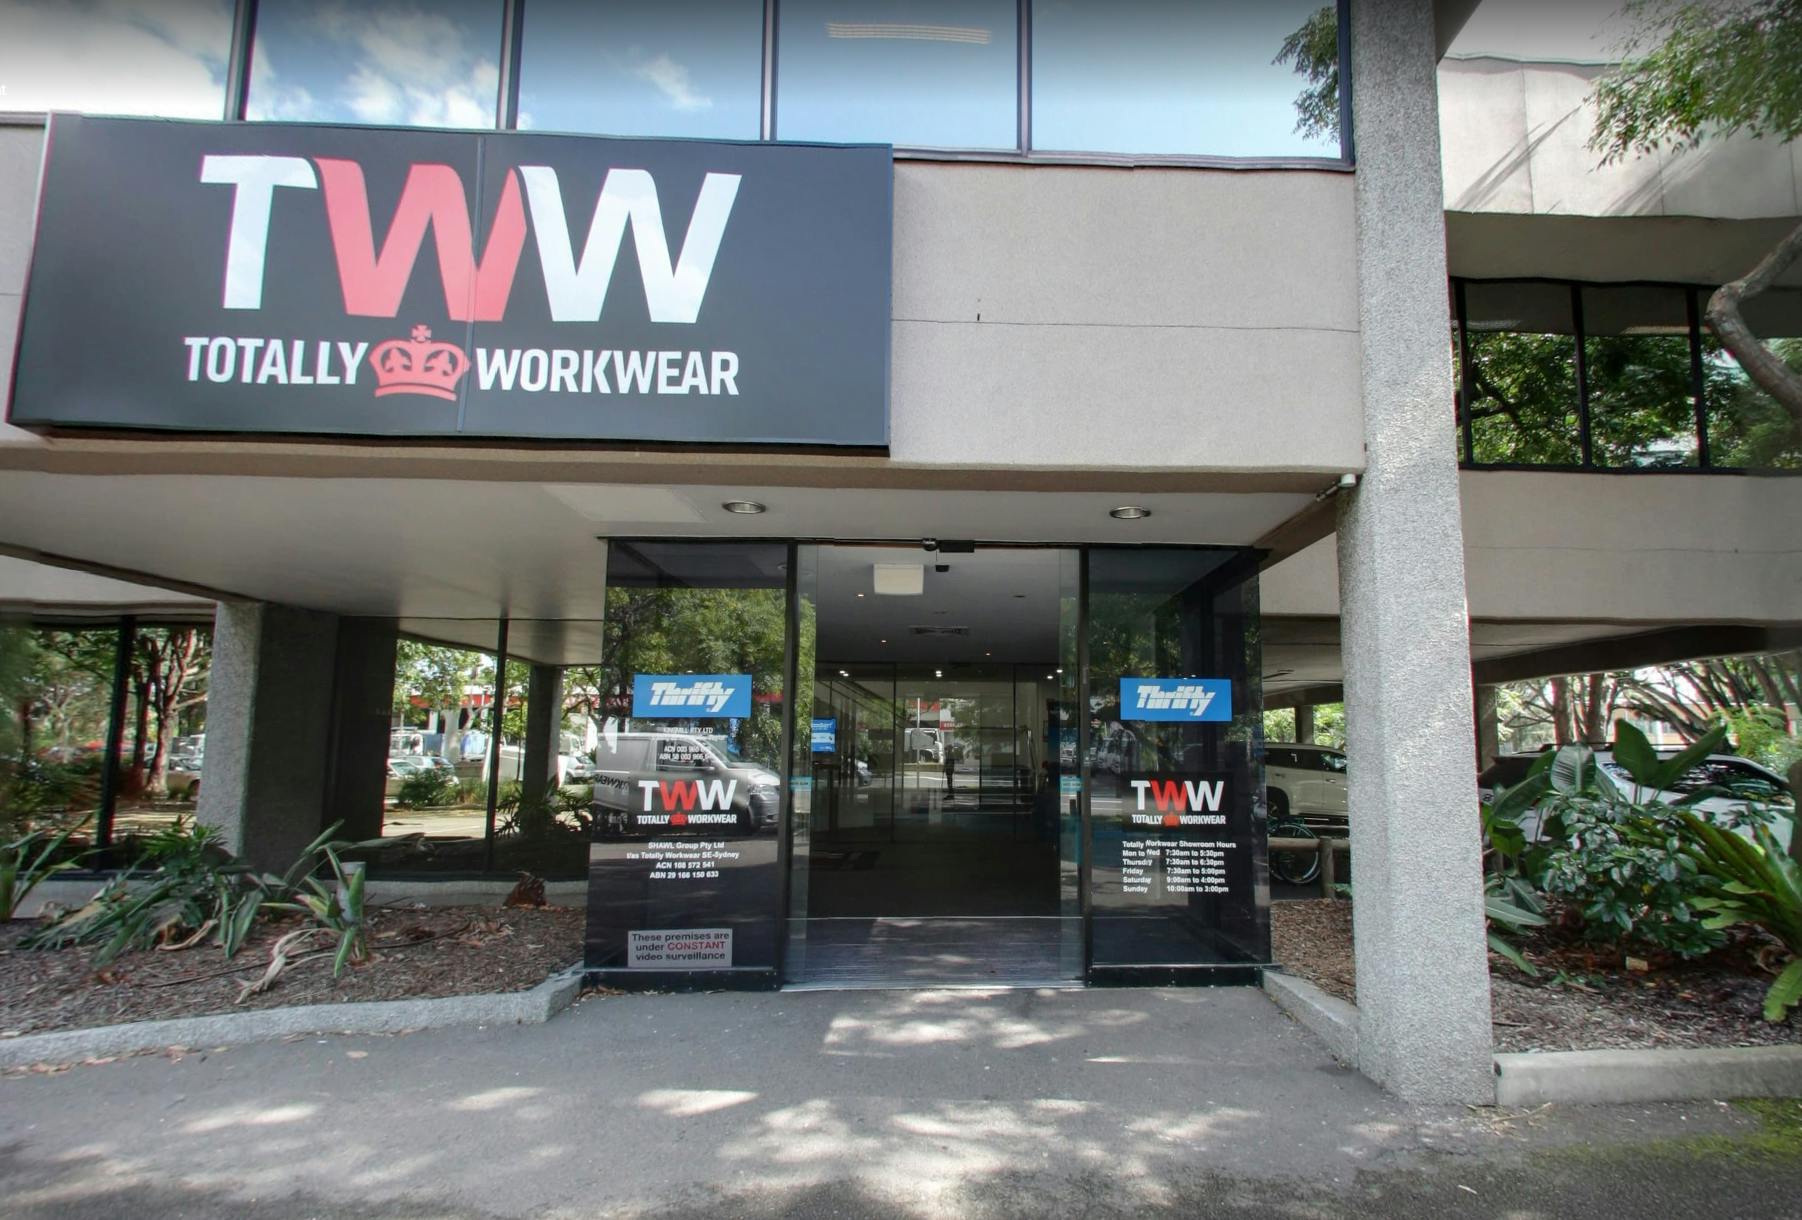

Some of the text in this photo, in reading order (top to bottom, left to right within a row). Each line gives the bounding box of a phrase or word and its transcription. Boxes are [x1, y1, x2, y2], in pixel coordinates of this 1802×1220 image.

[200, 155, 742, 323] TWW
[184, 337, 739, 396] TOTALLY WORKWEAR
[650, 682, 736, 712] Thrifty
[1137, 685, 1216, 716] Thrifty
[638, 779, 737, 811] TWW
[1131, 779, 1224, 812] TWW
[637, 814, 737, 825] TOTALLY WORKWEAR
[1132, 814, 1226, 824] TOTALLY WORKWEAR
[676, 842, 699, 850] Group
[700, 842, 712, 850] Pty
[1122, 841, 1144, 849] Totally
[641, 852, 664, 860] Totally
[702, 851, 739, 860] SE-Sydney
[1122, 868, 1144, 876] Friday
[1200, 877, 1226, 885] 4:00pm
[1123, 885, 1148, 893] Sunday
[632, 932, 729, 942] These premises are
[636, 941, 726, 951] under CONSTANT
[665, 951, 726, 960] surveillance
